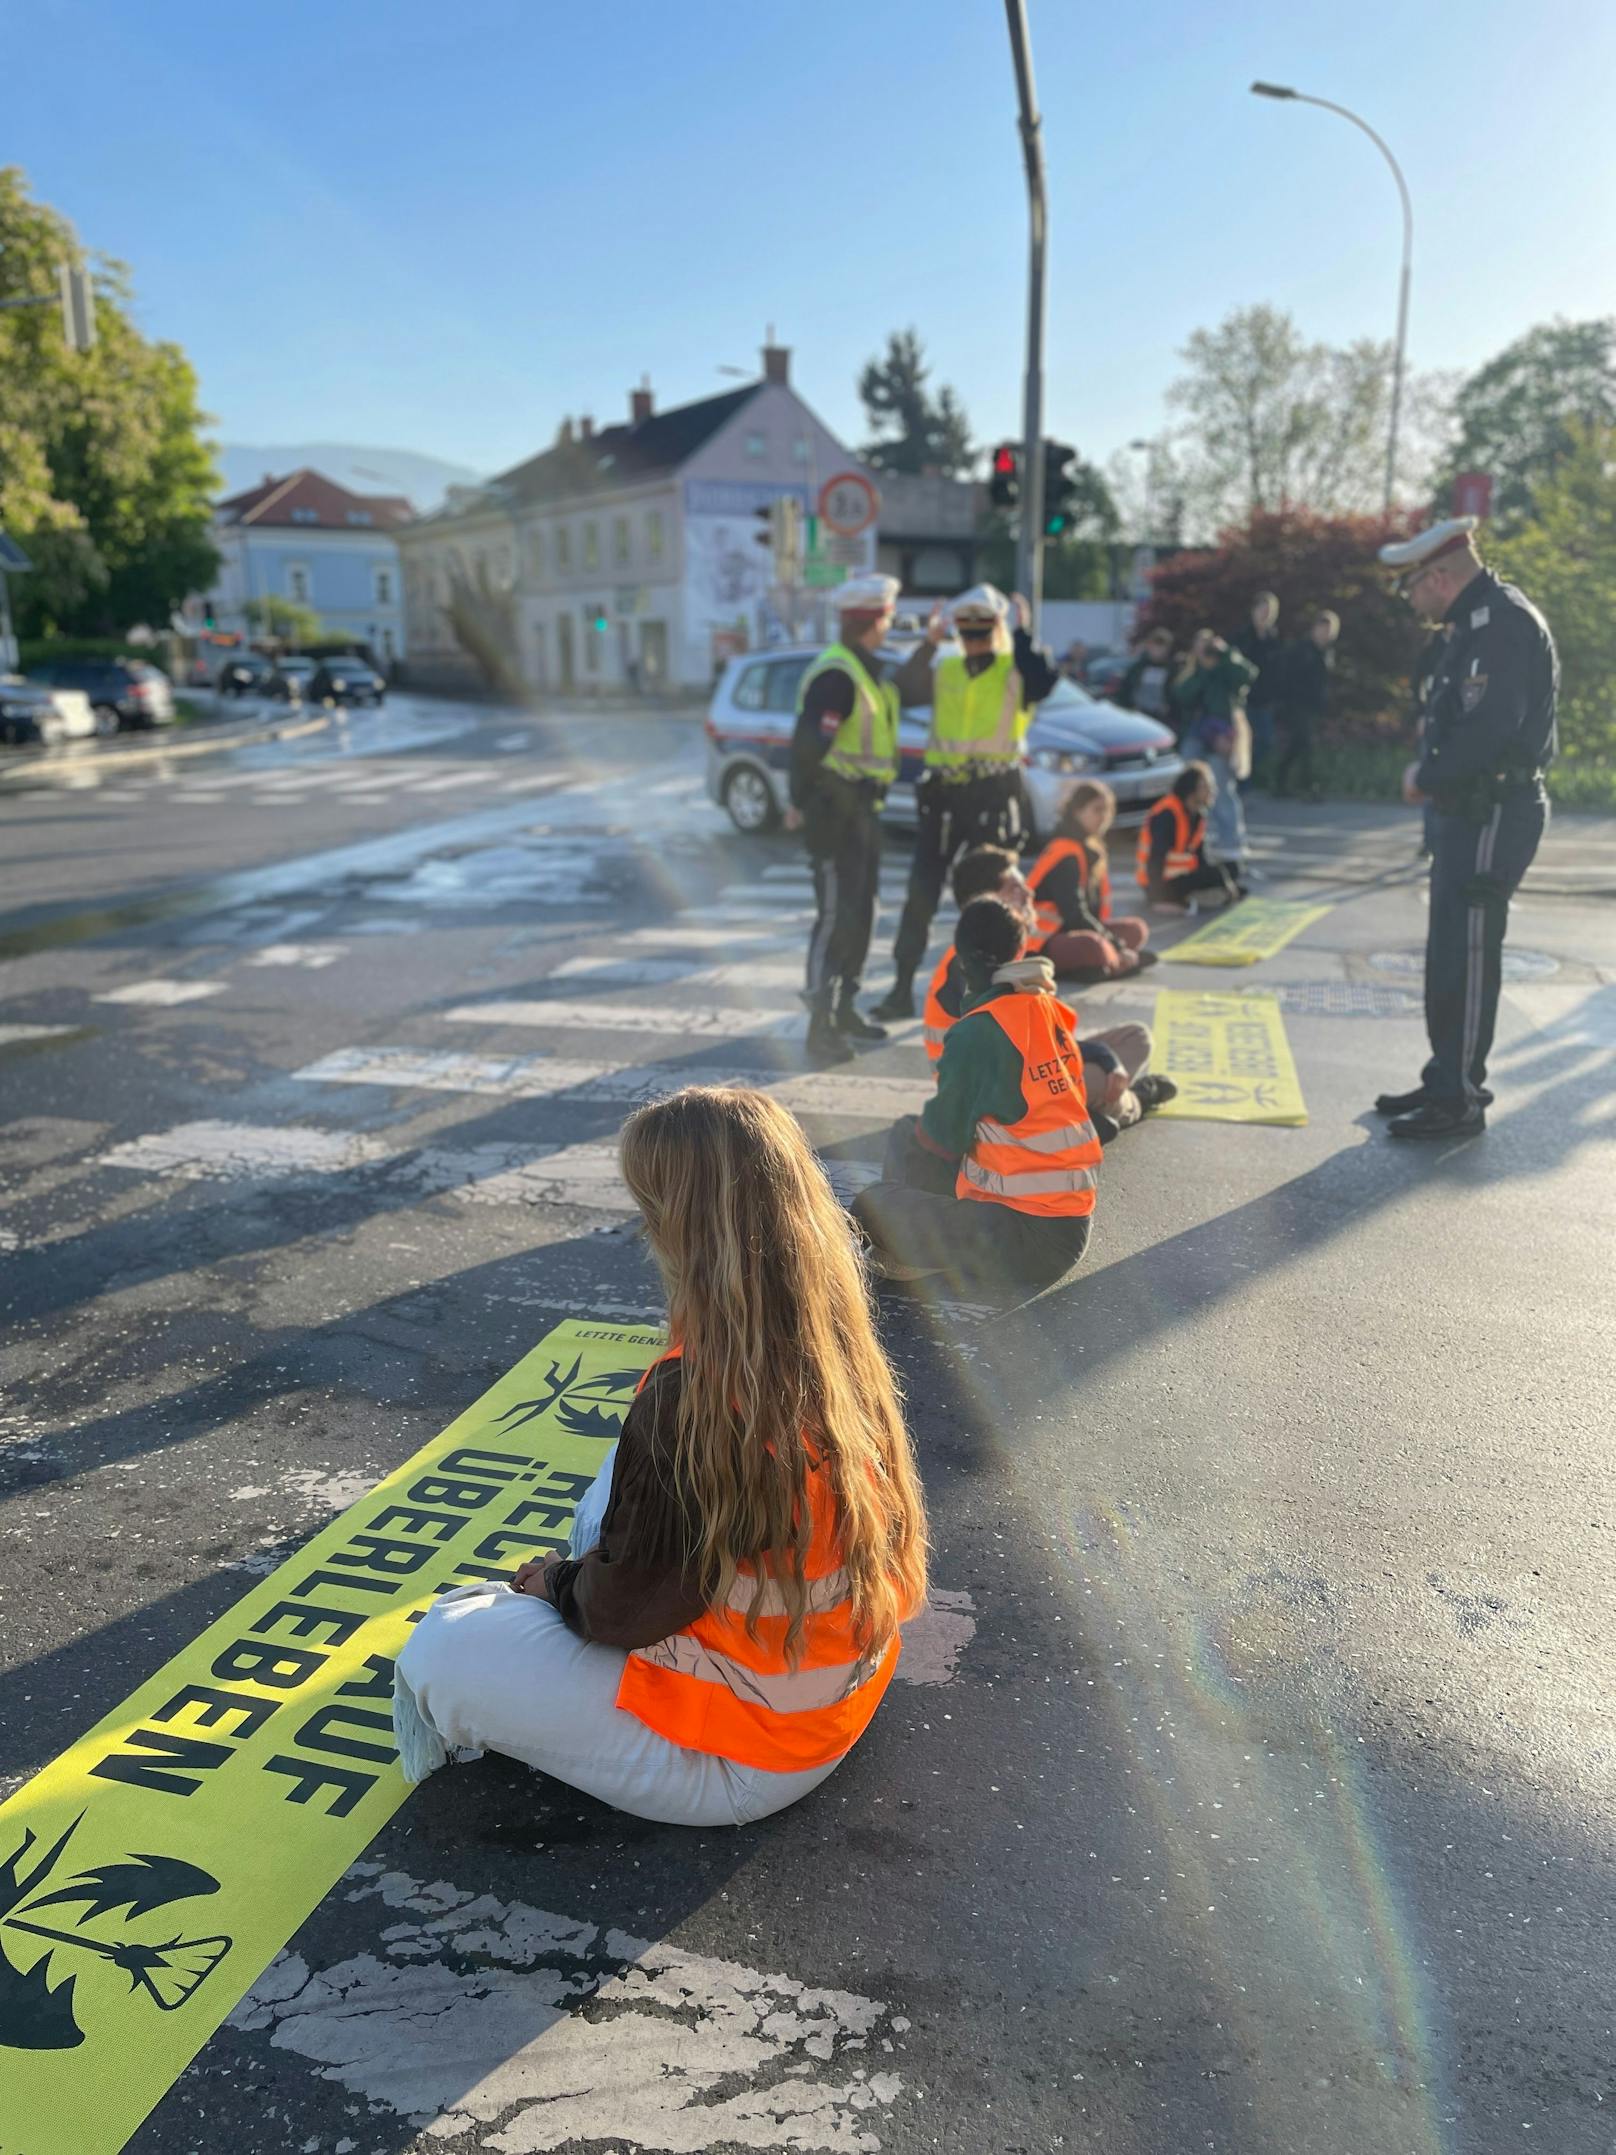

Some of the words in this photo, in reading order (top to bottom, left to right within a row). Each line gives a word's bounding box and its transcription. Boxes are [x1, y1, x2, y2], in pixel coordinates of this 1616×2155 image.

[576, 1330, 626, 1342] LETZTE
[628, 1335, 668, 1347] GENE
[88, 1449, 549, 1797] ÜBERLEBEN
[405, 1471, 597, 1624] REC
